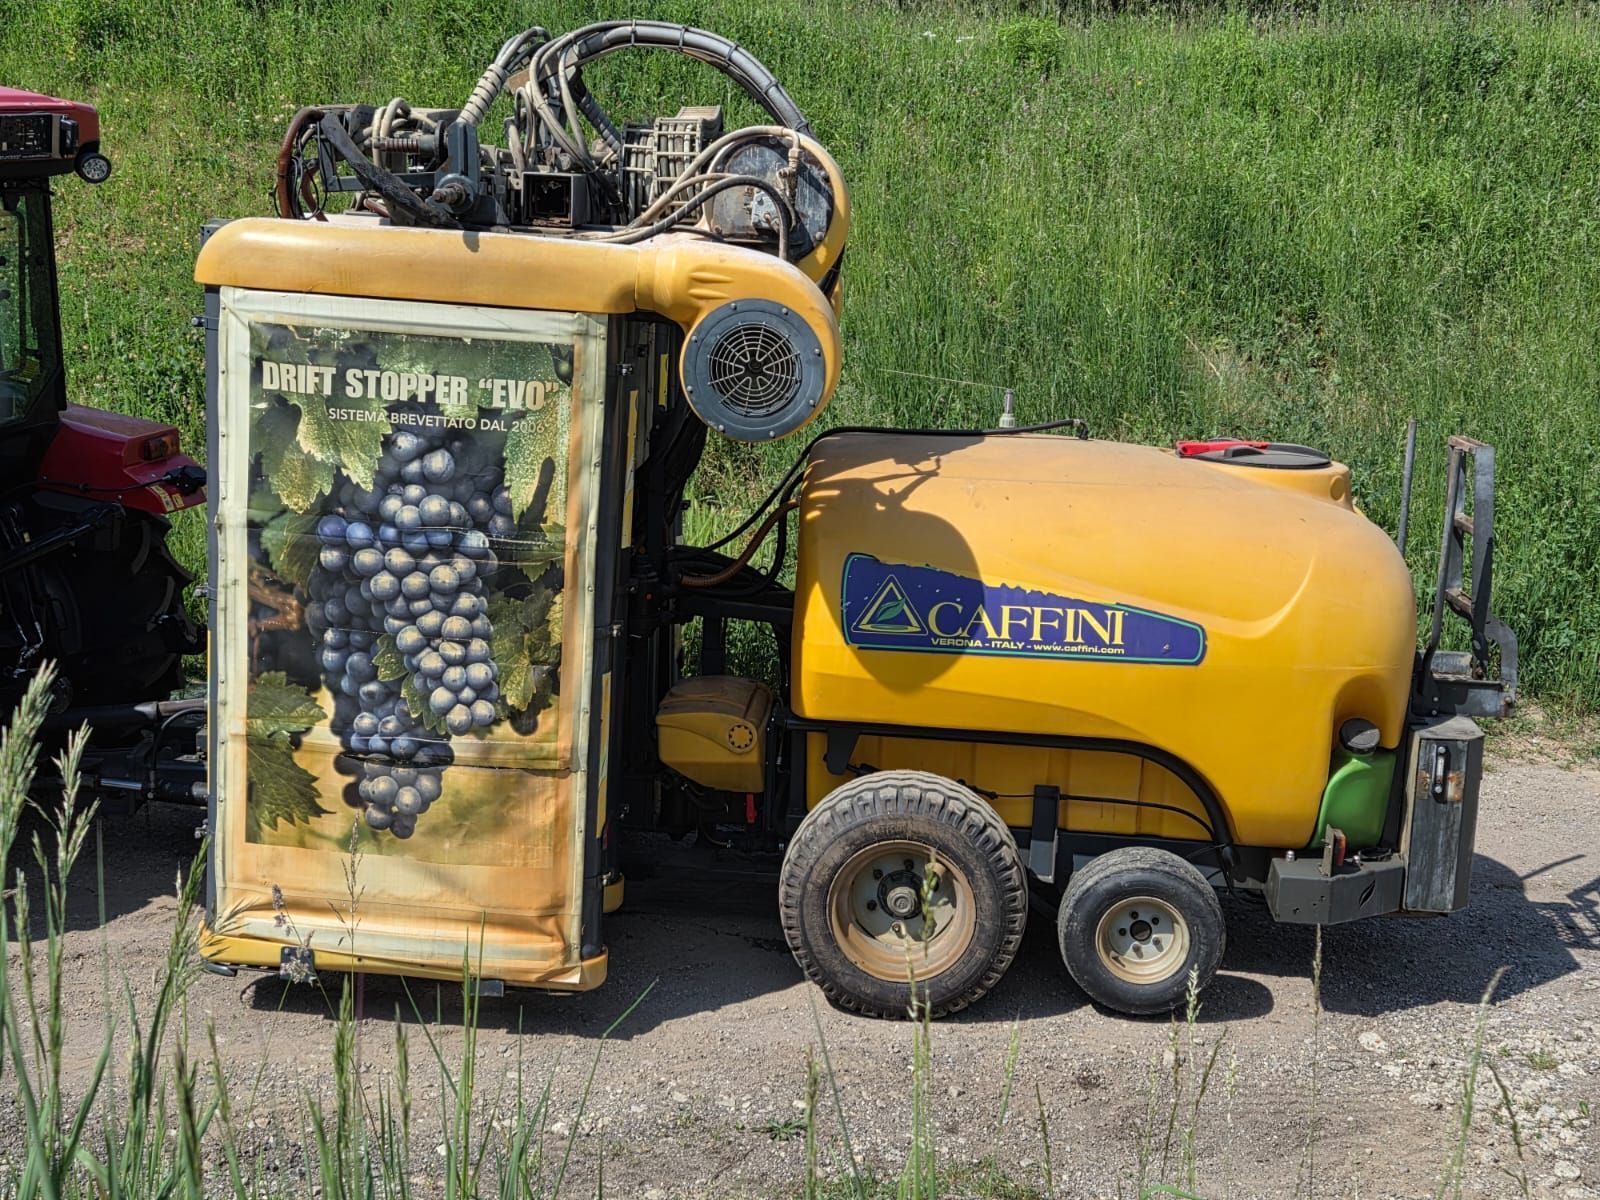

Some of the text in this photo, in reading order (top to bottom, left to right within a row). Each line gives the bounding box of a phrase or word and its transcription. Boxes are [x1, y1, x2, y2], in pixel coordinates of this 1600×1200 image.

[262, 361, 337, 395] DRIFT
[345, 368, 468, 405] STOPPER
[328, 407, 545, 434] SISTEMA BREVETTATO DAL 2006
[927, 601, 1126, 646] CAFFINI
[931, 637, 983, 648] VERONA
[991, 640, 1025, 650] ITALY
[1033, 643, 1125, 655] www.caffini.com
